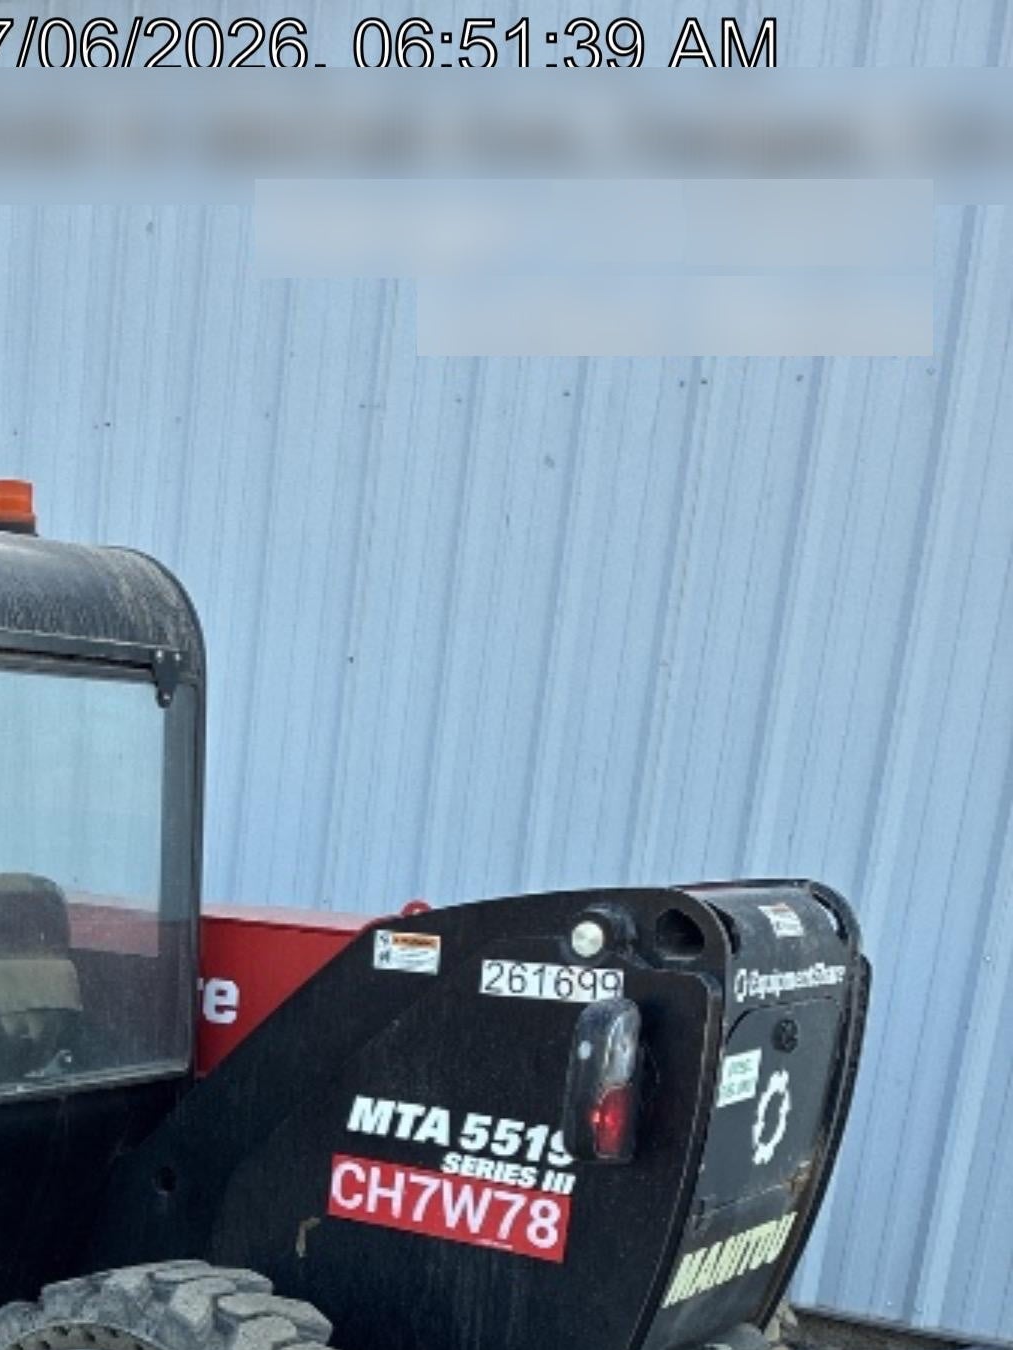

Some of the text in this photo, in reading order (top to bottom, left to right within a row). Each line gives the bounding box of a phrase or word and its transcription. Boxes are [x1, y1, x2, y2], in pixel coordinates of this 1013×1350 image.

[483, 961, 622, 1001] 261699
[346, 1094, 451, 1147] MTA
[440, 1151, 538, 1189] SERIES
[330, 1160, 562, 1250] CH7W78
[661, 1211, 798, 1309] MANITOU
